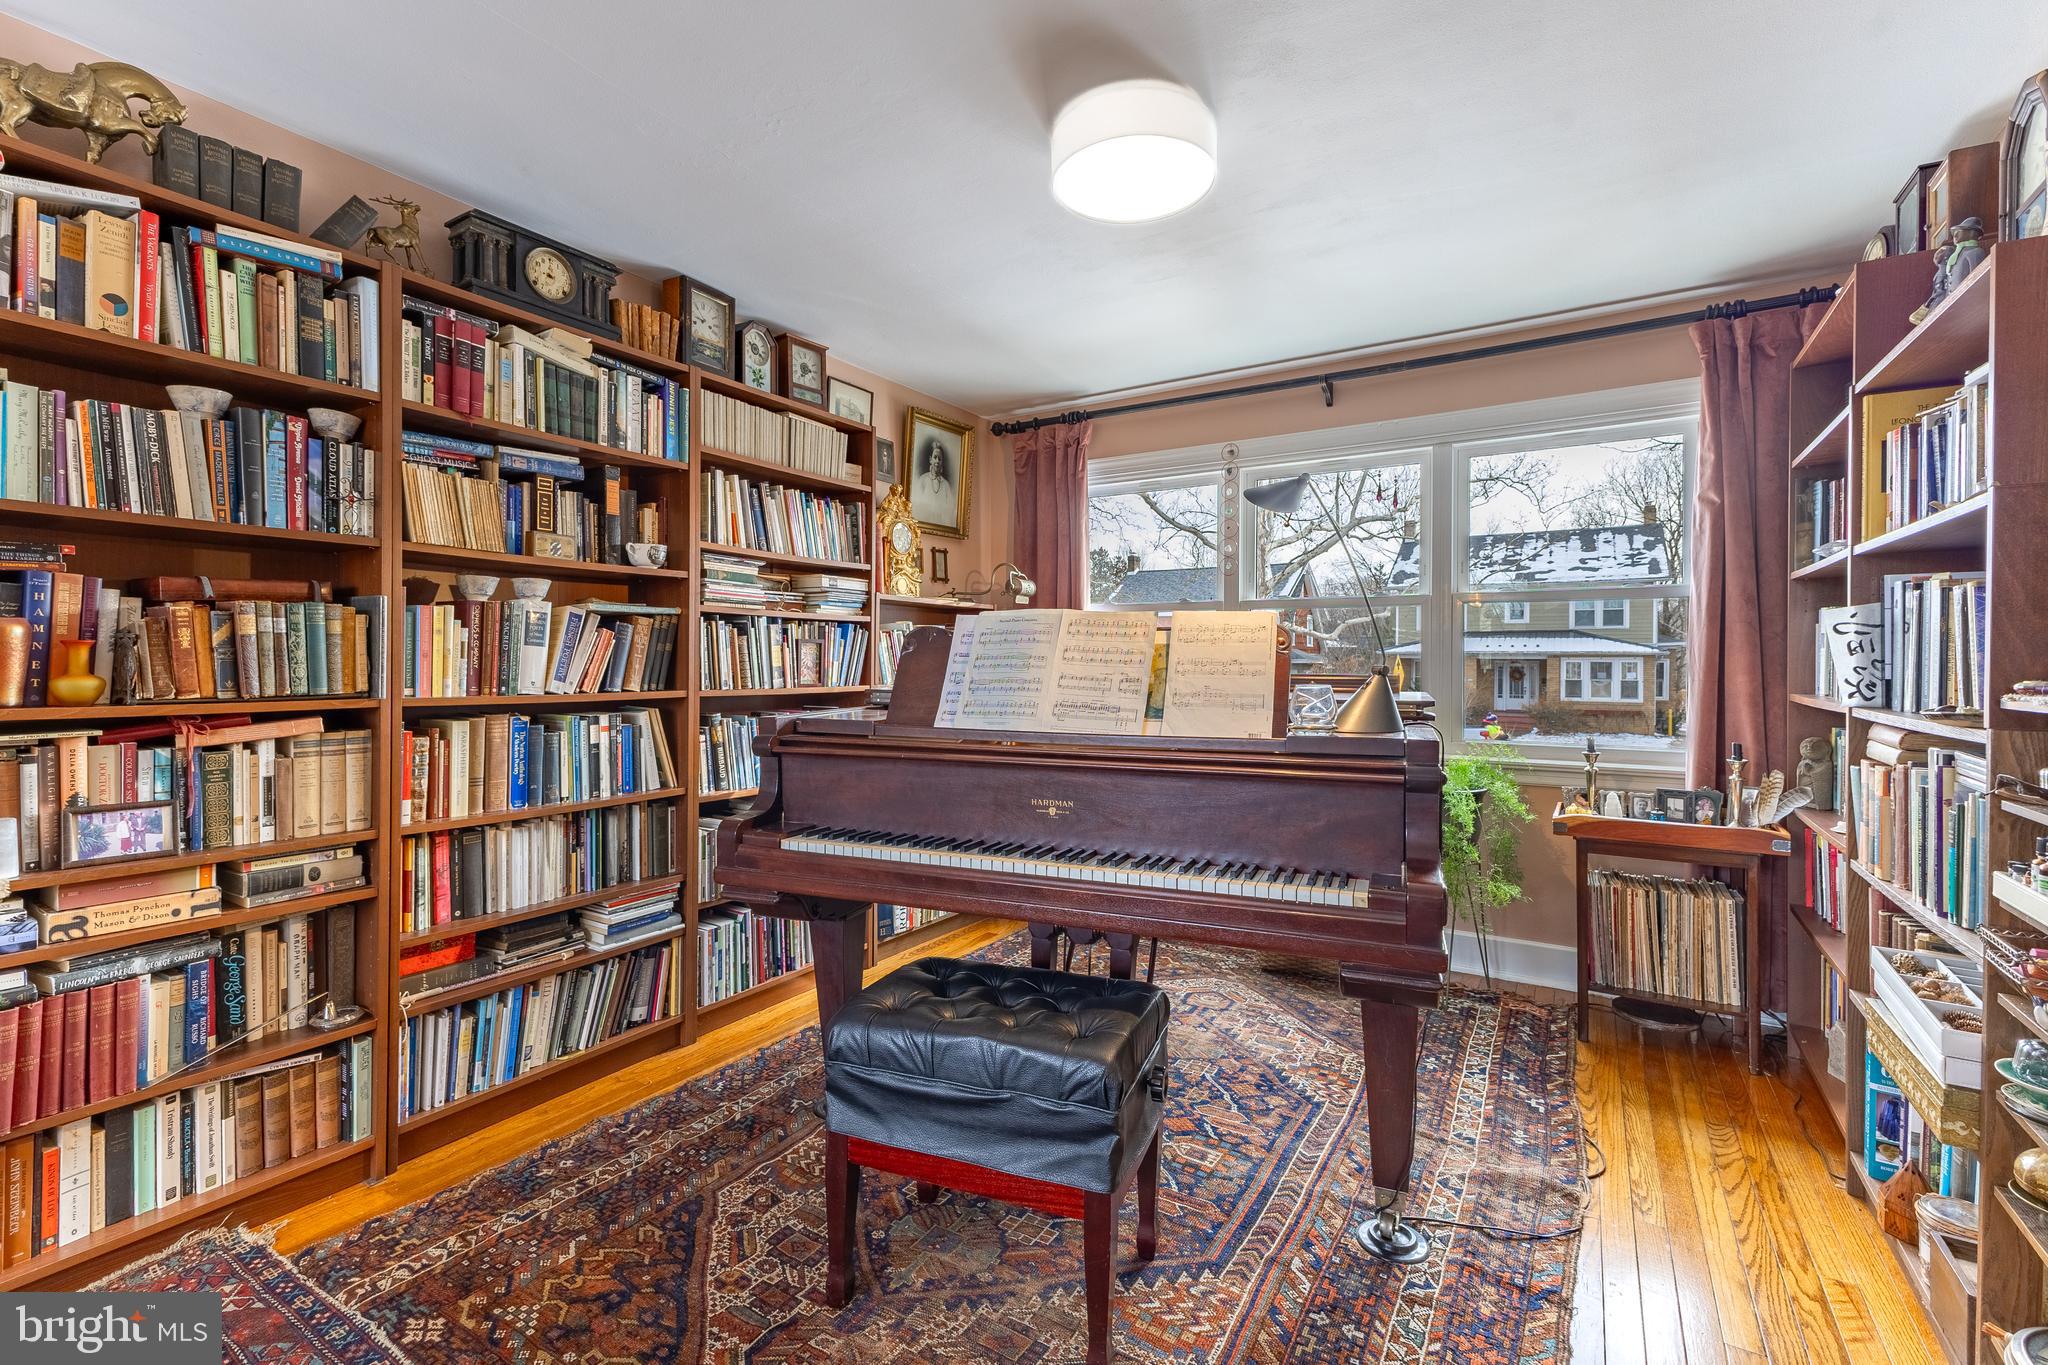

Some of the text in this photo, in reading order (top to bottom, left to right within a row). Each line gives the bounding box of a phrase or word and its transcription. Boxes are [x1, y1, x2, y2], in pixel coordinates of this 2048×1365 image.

[100, 224, 129, 240] Zenith
[147, 223, 157, 234] THE
[146, 237, 156, 271] VAGRANTS
[221, 238, 315, 267] ALISON LURIE
[26, 267, 34, 296] SINGING
[98, 312, 129, 326] Sinclair
[102, 321, 127, 332] Lewis
[100, 404, 114, 480] Ian McEwan Atonement
[146, 412, 160, 463] MOBY-DICK
[213, 428, 225, 505] CIRCE MADELINE MILLER
[409, 453, 472, 468] GHOST MUSIC
[31, 592, 45, 687] HAMNET
[558, 617, 579, 678] FRENCH POETRY
[47, 752, 55, 808] WARLIGHT
[125, 758, 133, 783] COLOUR
[125, 790, 133, 802] SNO
[1031, 798, 1074, 808] HARDMAN
[93, 902, 171, 919] Thomas Pynchon
[93, 919, 125, 929] Mason
[143, 911, 170, 921] Dixon
[60, 976, 94, 990] LINCOLN
[145, 957, 171, 969] GEORGE
[173, 950, 205, 965] SAUNDERS
[200, 996, 207, 1005] OF
[223, 955, 247, 1026] George Sand
[191, 1024, 199, 1044] RUSSO
[166, 1108, 175, 1159] Tristram Shandy
[183, 1117, 191, 1145] DRACULA
[46, 1163, 55, 1185] KINDS
[207, 1156, 215, 1168] Swift
[9, 1159, 20, 1235] JOHN STEINBECK
[46, 1187, 55, 1197] OF
